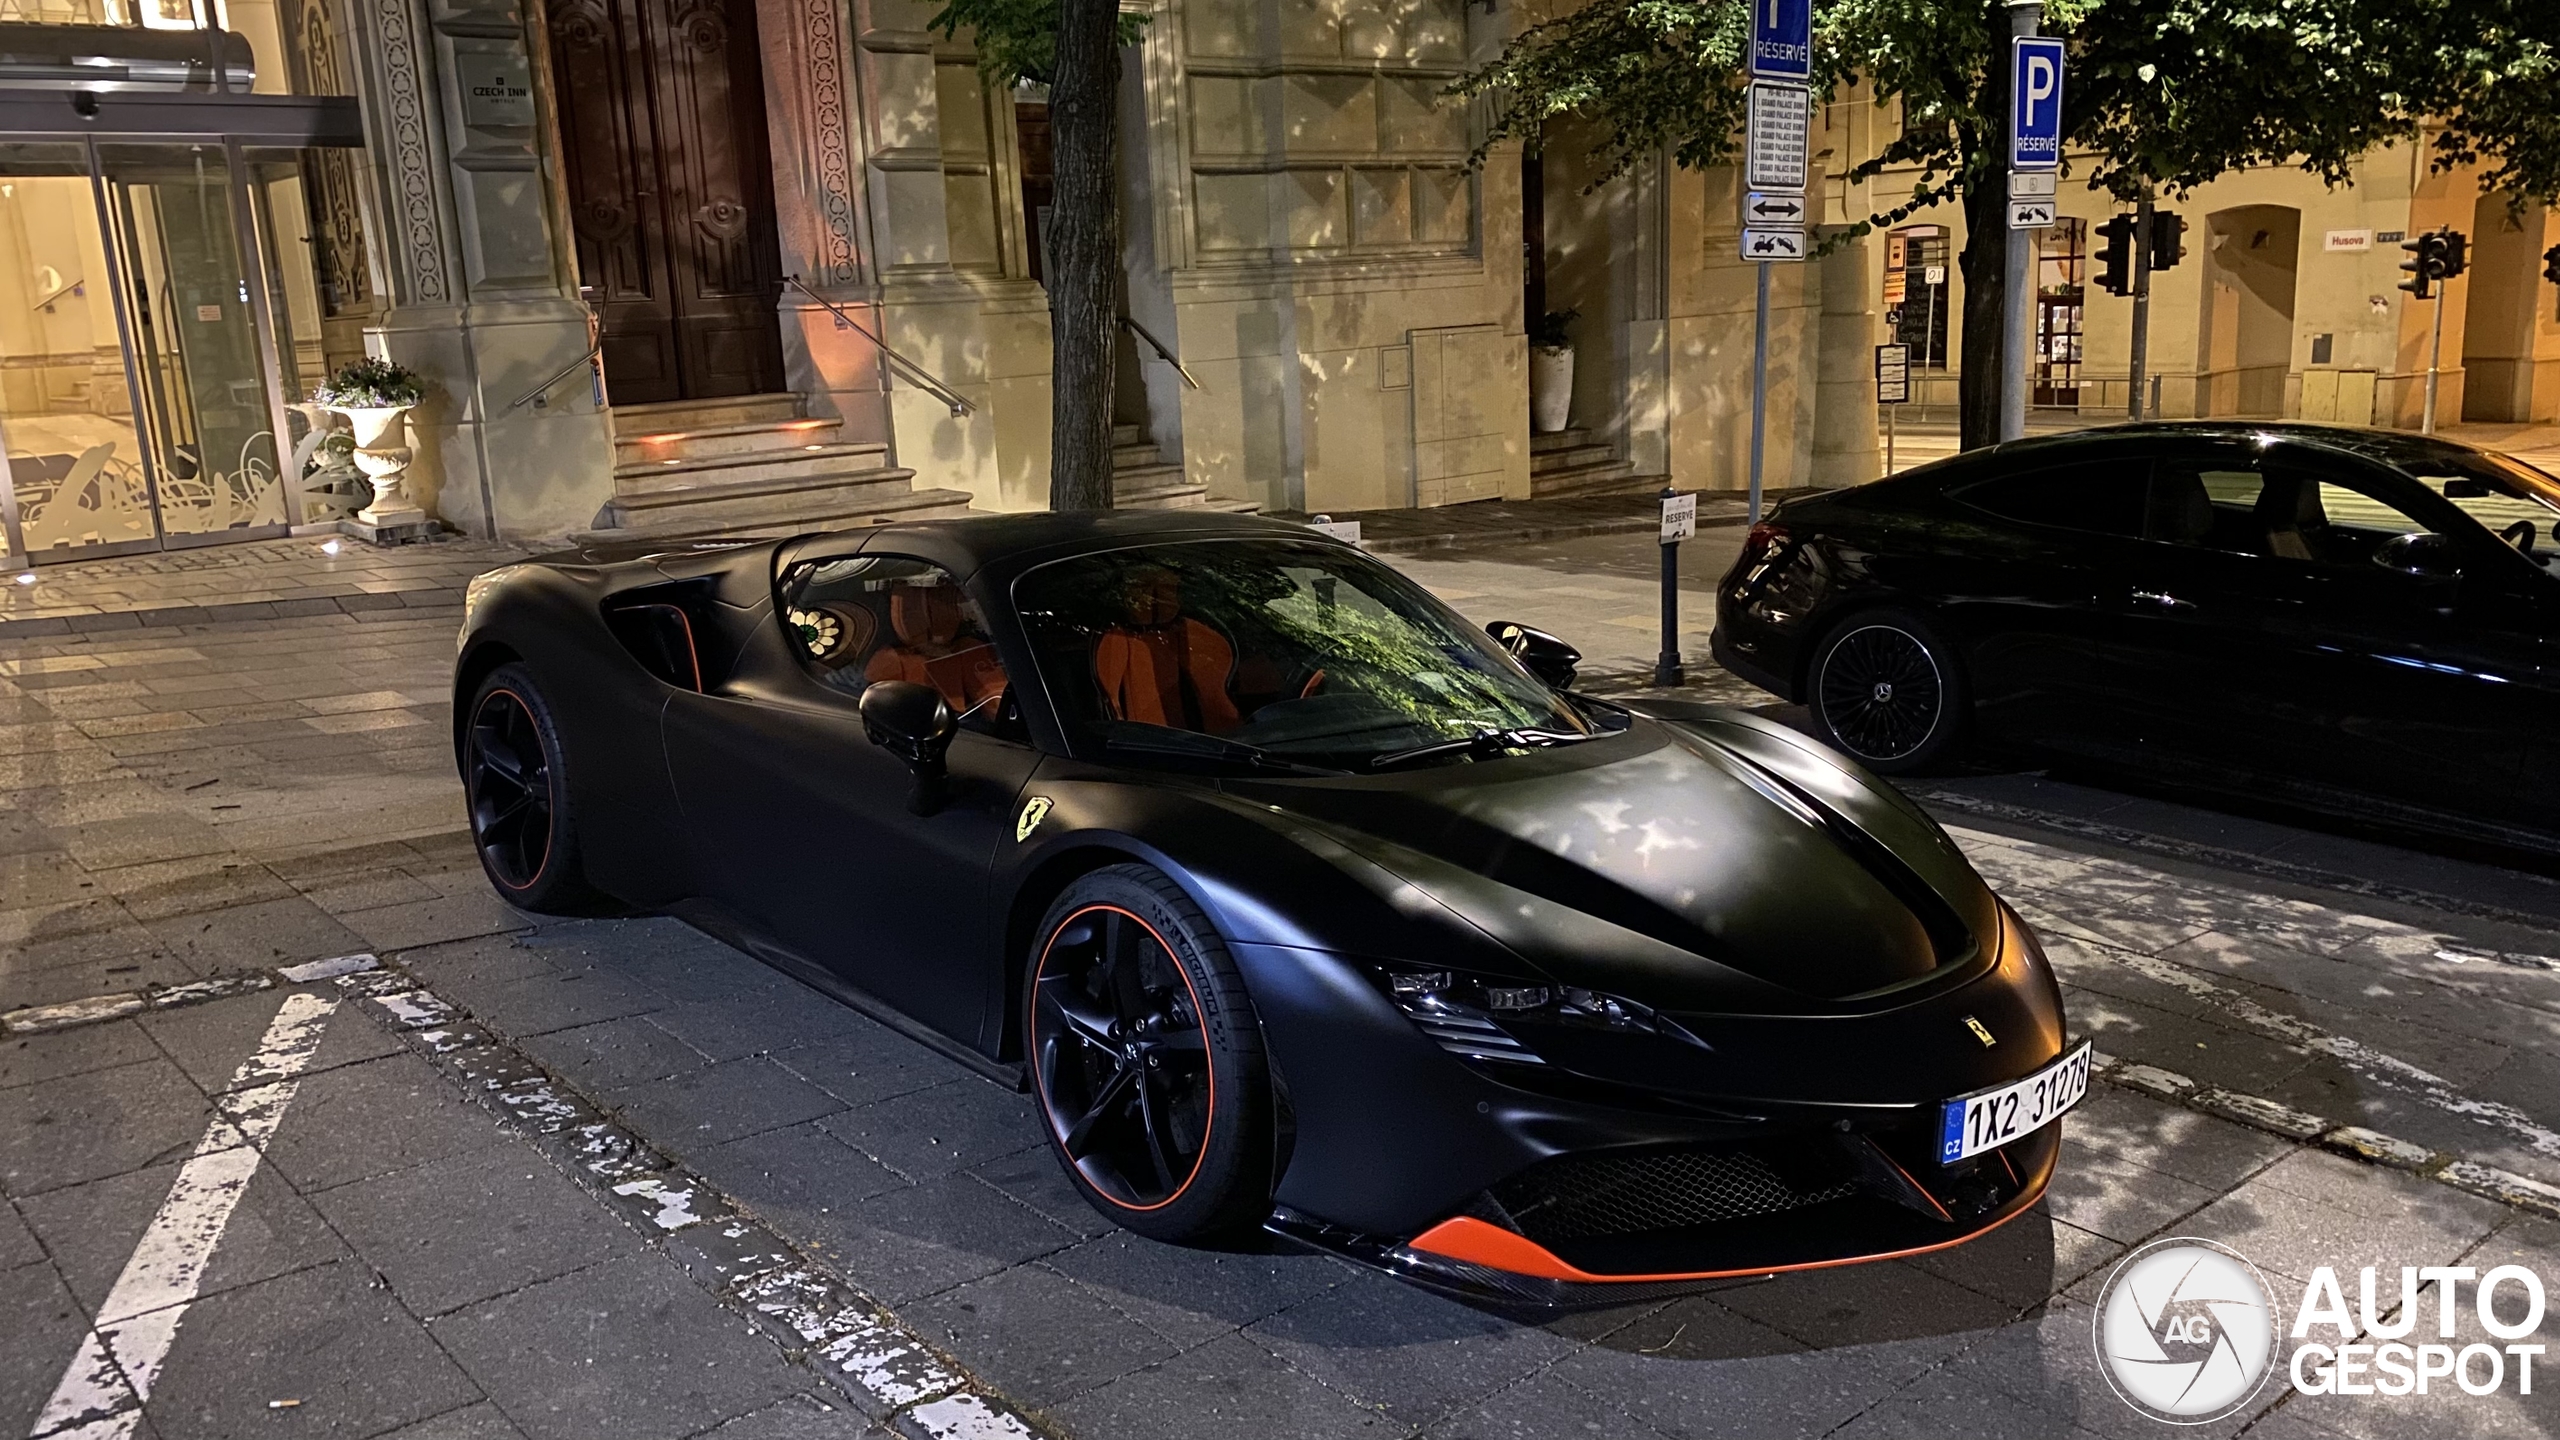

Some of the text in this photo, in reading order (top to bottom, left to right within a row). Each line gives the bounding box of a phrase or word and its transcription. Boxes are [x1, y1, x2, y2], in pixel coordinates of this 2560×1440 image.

[1757, 38, 1807, 62] RÉSERVÉ
[473, 87, 527, 97] CZECH INN
[2026, 56, 2054, 126] P
[2018, 134, 2056, 151] RÉSERVÉ
[2332, 236, 2364, 246] Husova
[1181, 942, 1218, 1015] MICHELIN
[1968, 1051, 2087, 1149] 1X2 31278
[1945, 1139, 1960, 1155] CZ
